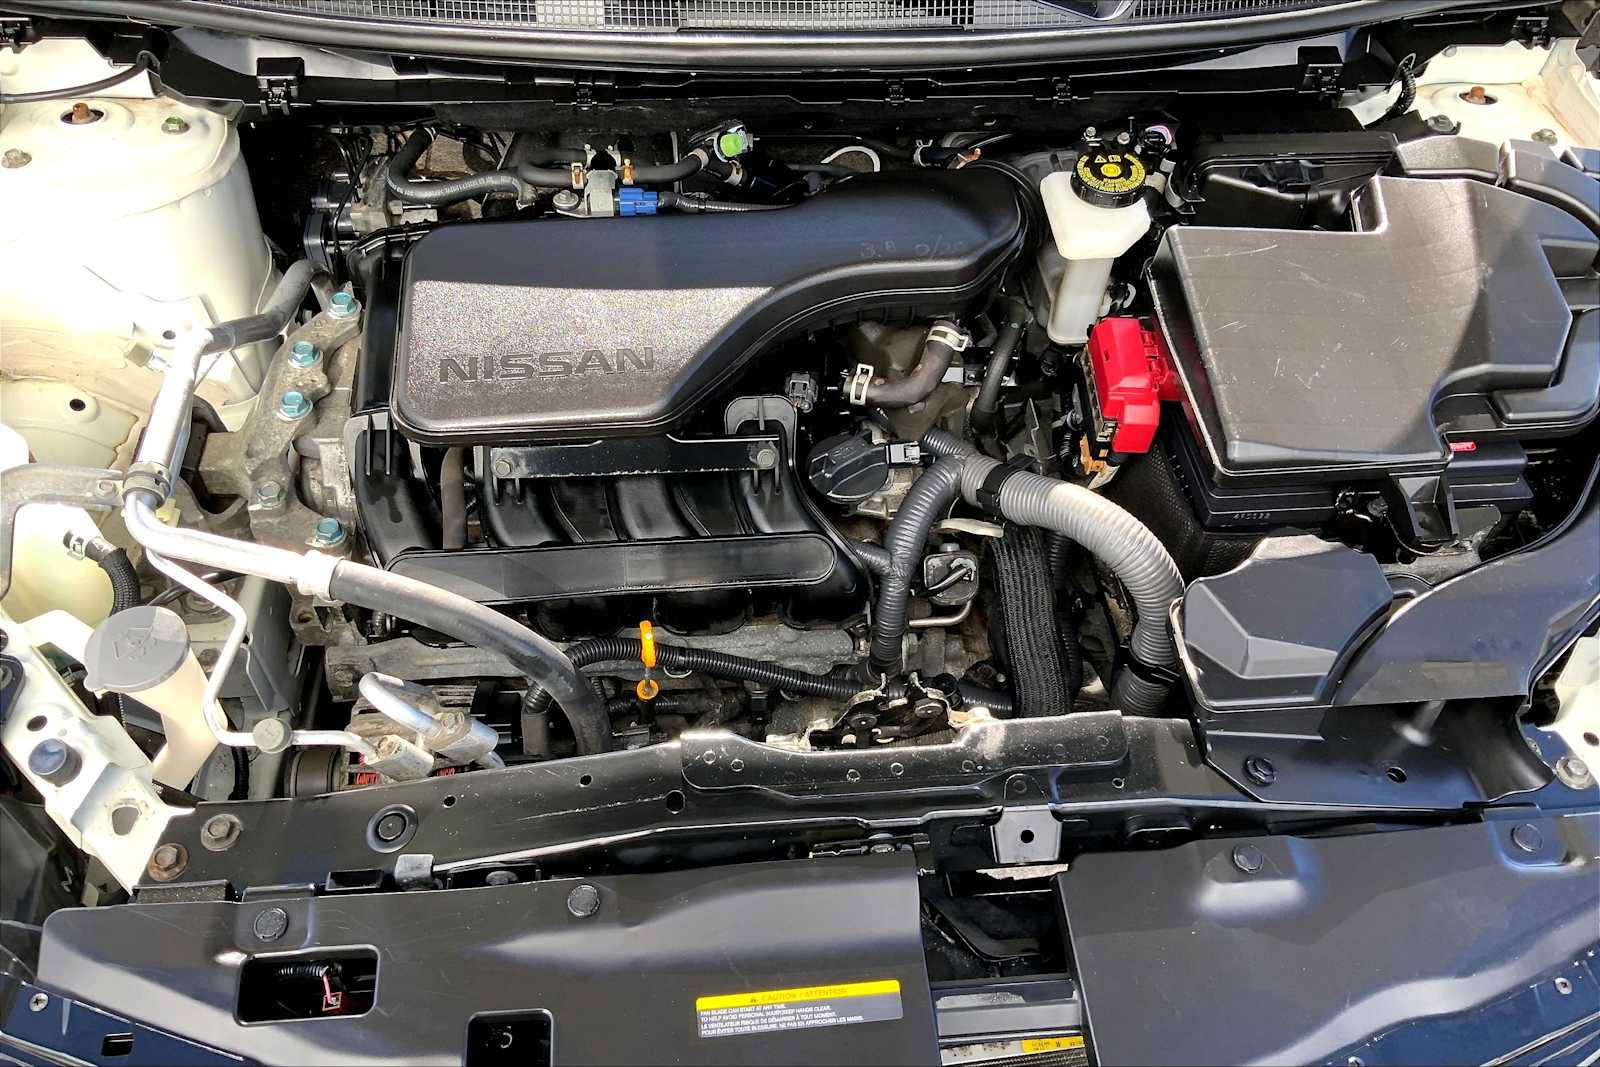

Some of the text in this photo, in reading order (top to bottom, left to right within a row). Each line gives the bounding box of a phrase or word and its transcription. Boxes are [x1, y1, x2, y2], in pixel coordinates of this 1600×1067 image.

[439, 347, 654, 384] NISSAN
[762, 992, 796, 1002] CAUTION
[804, 988, 847, 998] ATTENTION
